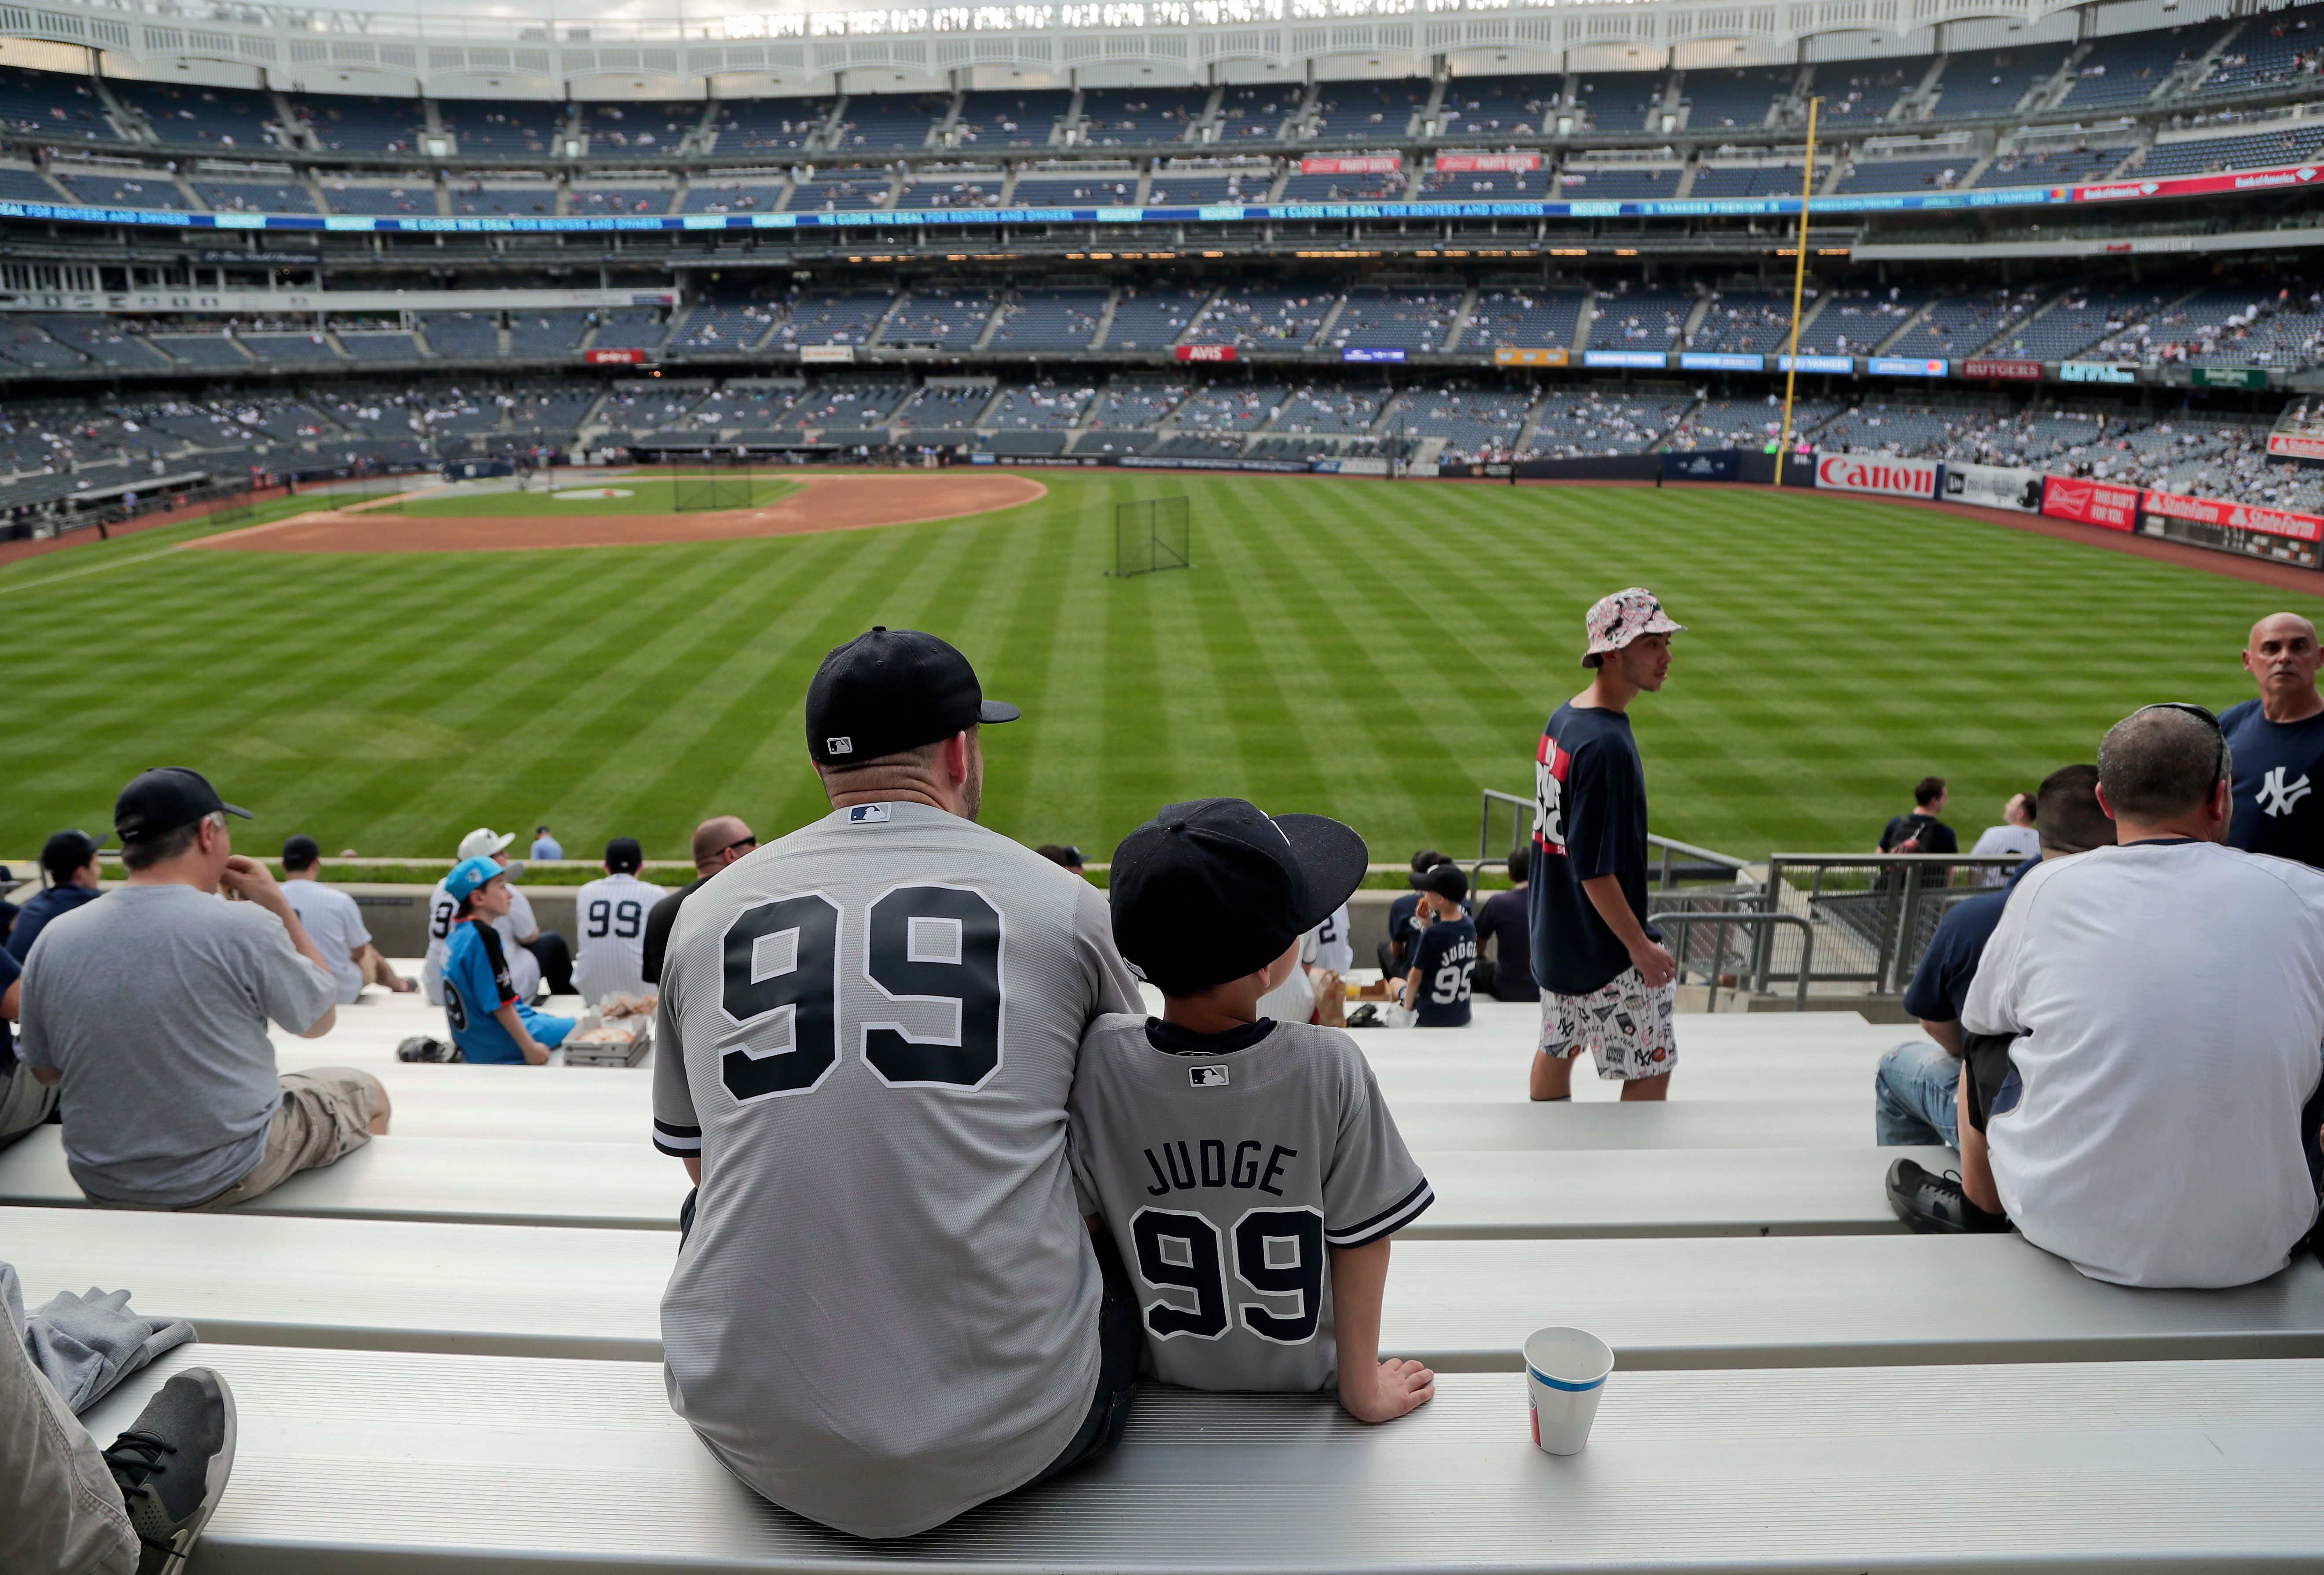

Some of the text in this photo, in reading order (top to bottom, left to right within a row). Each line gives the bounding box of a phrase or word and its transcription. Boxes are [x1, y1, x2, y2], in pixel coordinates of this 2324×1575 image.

[0, 202, 25, 216] EAL
[108, 210, 137, 223] AND
[1267, 204, 1543, 219] WE CLOSE THE DEAL FOR RENTERS AND OWNERS
[1570, 201, 1622, 216] INSURENT
[1808, 198, 1903, 211] ANKEES.COM/PREMIUM
[836, 213, 872, 225] CLOSE
[894, 212, 924, 225] DEAL
[925, 212, 949, 224] FOR
[949, 211, 999, 223] RENTERS
[999, 211, 1024, 223] AND
[1025, 210, 1074, 222] OWNERS
[1189, 346, 1223, 360] AVIS
[1966, 363, 2039, 377] RUTGERS
[1820, 457, 1933, 493] Canon
[2093, 488, 2135, 510] THIS BUD'S
[2092, 505, 2107, 520] FOR
[2255, 766, 2312, 818] NY
[588, 901, 641, 938] 99
[719, 881, 1006, 1107] 99
[1144, 1139, 1298, 1197] JUDGE
[1129, 1205, 1326, 1345] 99
